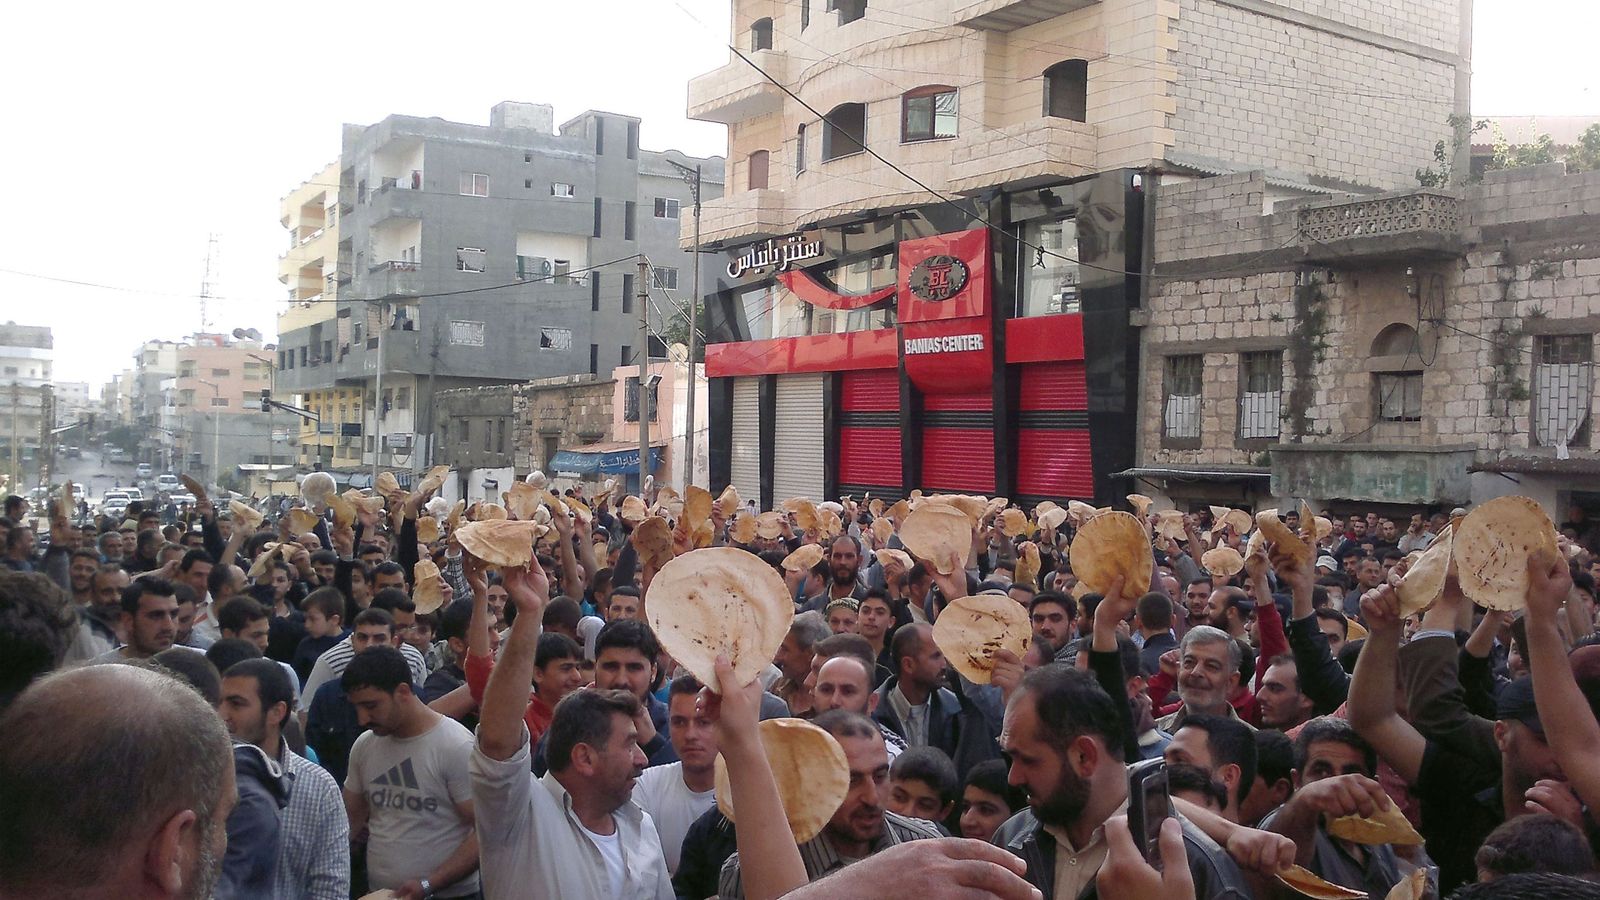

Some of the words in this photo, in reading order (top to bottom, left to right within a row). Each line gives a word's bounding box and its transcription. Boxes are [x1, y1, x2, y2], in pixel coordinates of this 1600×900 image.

[726, 239, 779, 278] بانياس
[779, 236, 820, 271] سنتر
[904, 336, 941, 355] BANIAS
[942, 334, 984, 352] CENTER
[366, 788, 438, 812] didas
